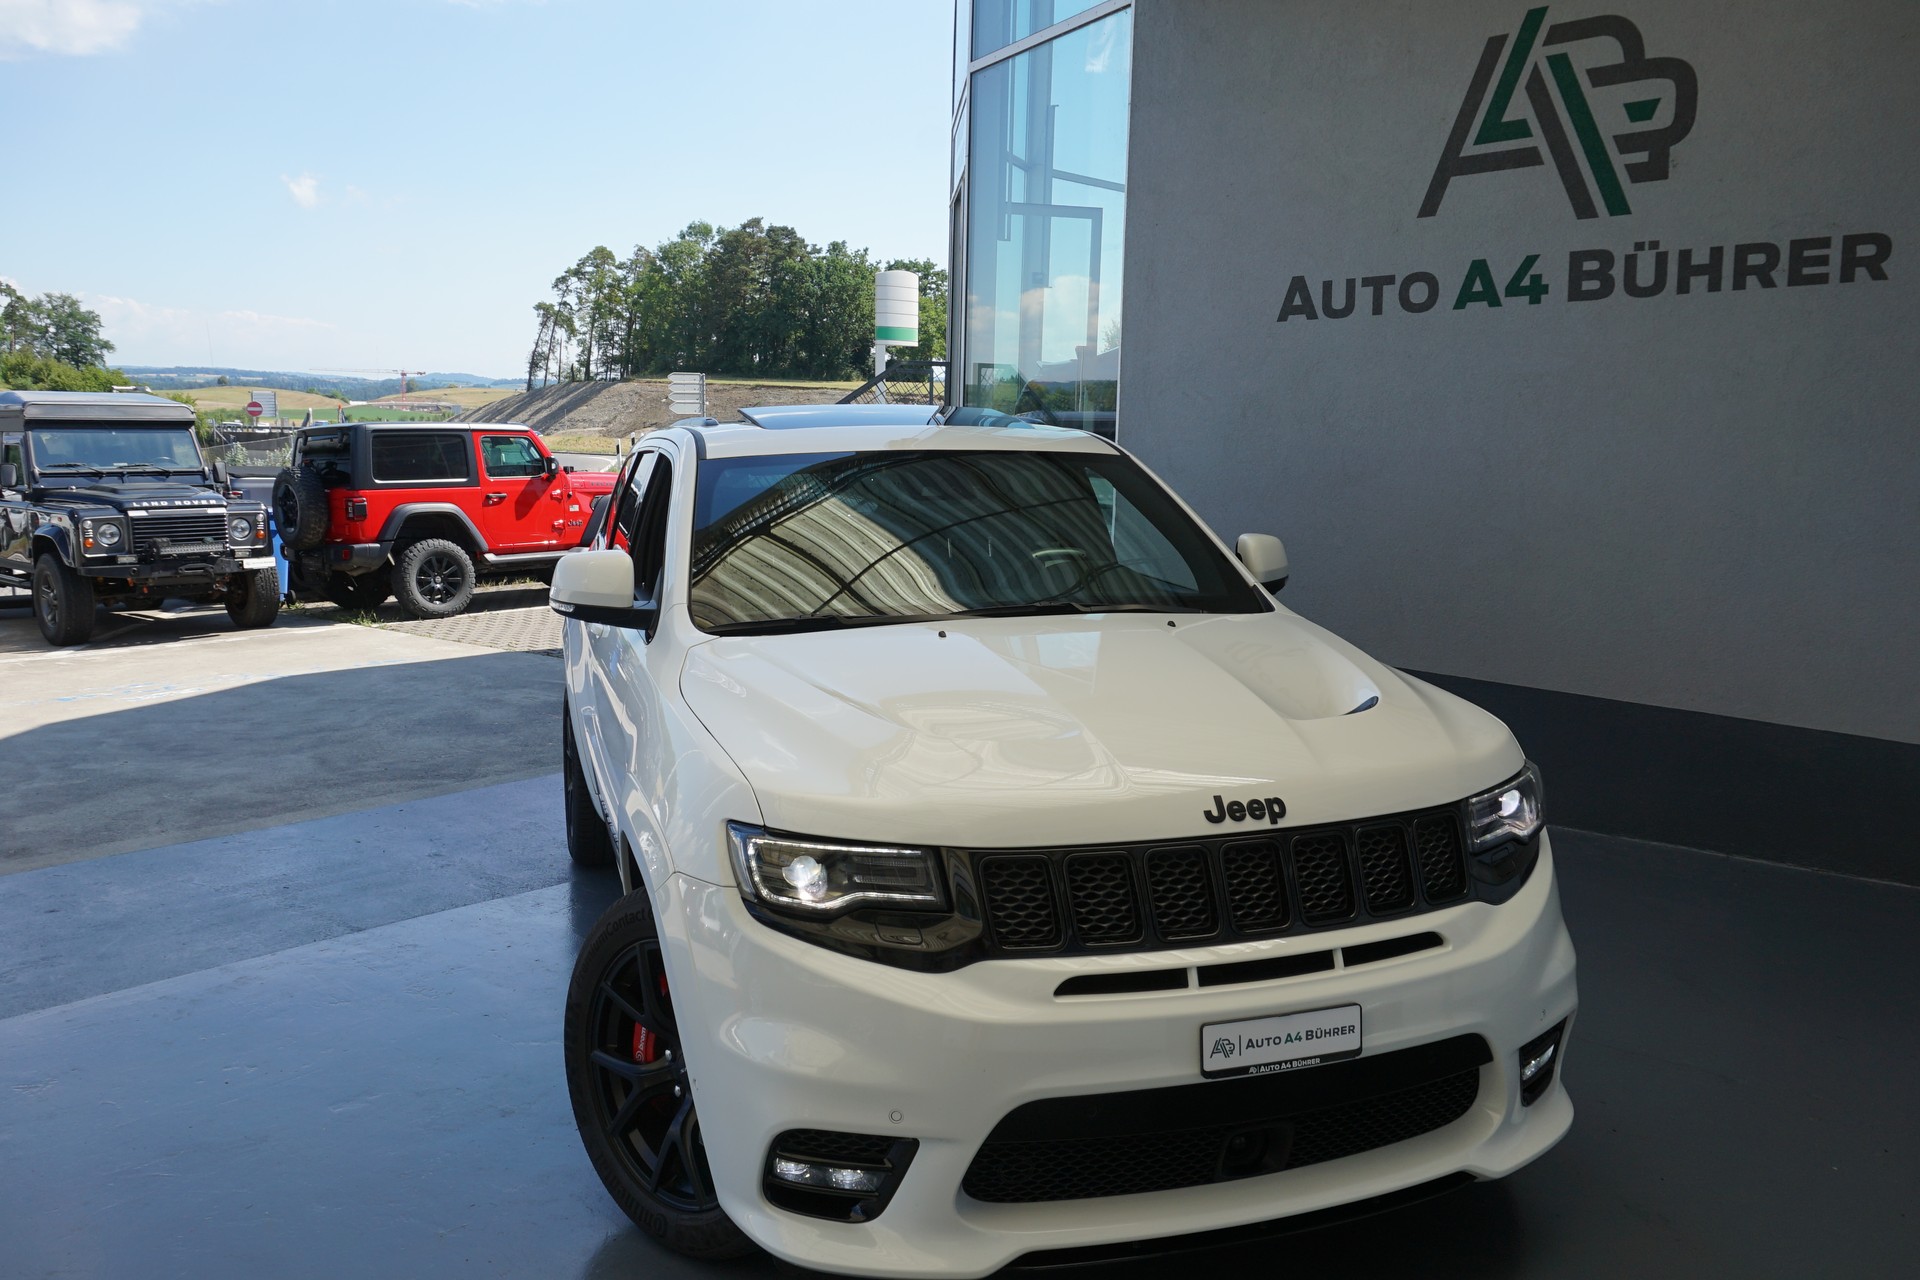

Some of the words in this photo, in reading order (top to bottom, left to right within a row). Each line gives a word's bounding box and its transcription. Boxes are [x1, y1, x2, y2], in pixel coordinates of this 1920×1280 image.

[1276, 271, 1440, 322] AUTO
[1452, 253, 1549, 310] A4
[1567, 232, 1893, 302] BÜHRER
[1203, 795, 1287, 825] Jeep
[1245, 1035, 1282, 1050] AUTO
[1284, 1031, 1302, 1045] A4
[1305, 1025, 1355, 1041] BÜHRER
[1260, 1064, 1280, 1073] AUTO
[1281, 1061, 1292, 1069] A4
[1292, 1058, 1320, 1068] BÜHRER
